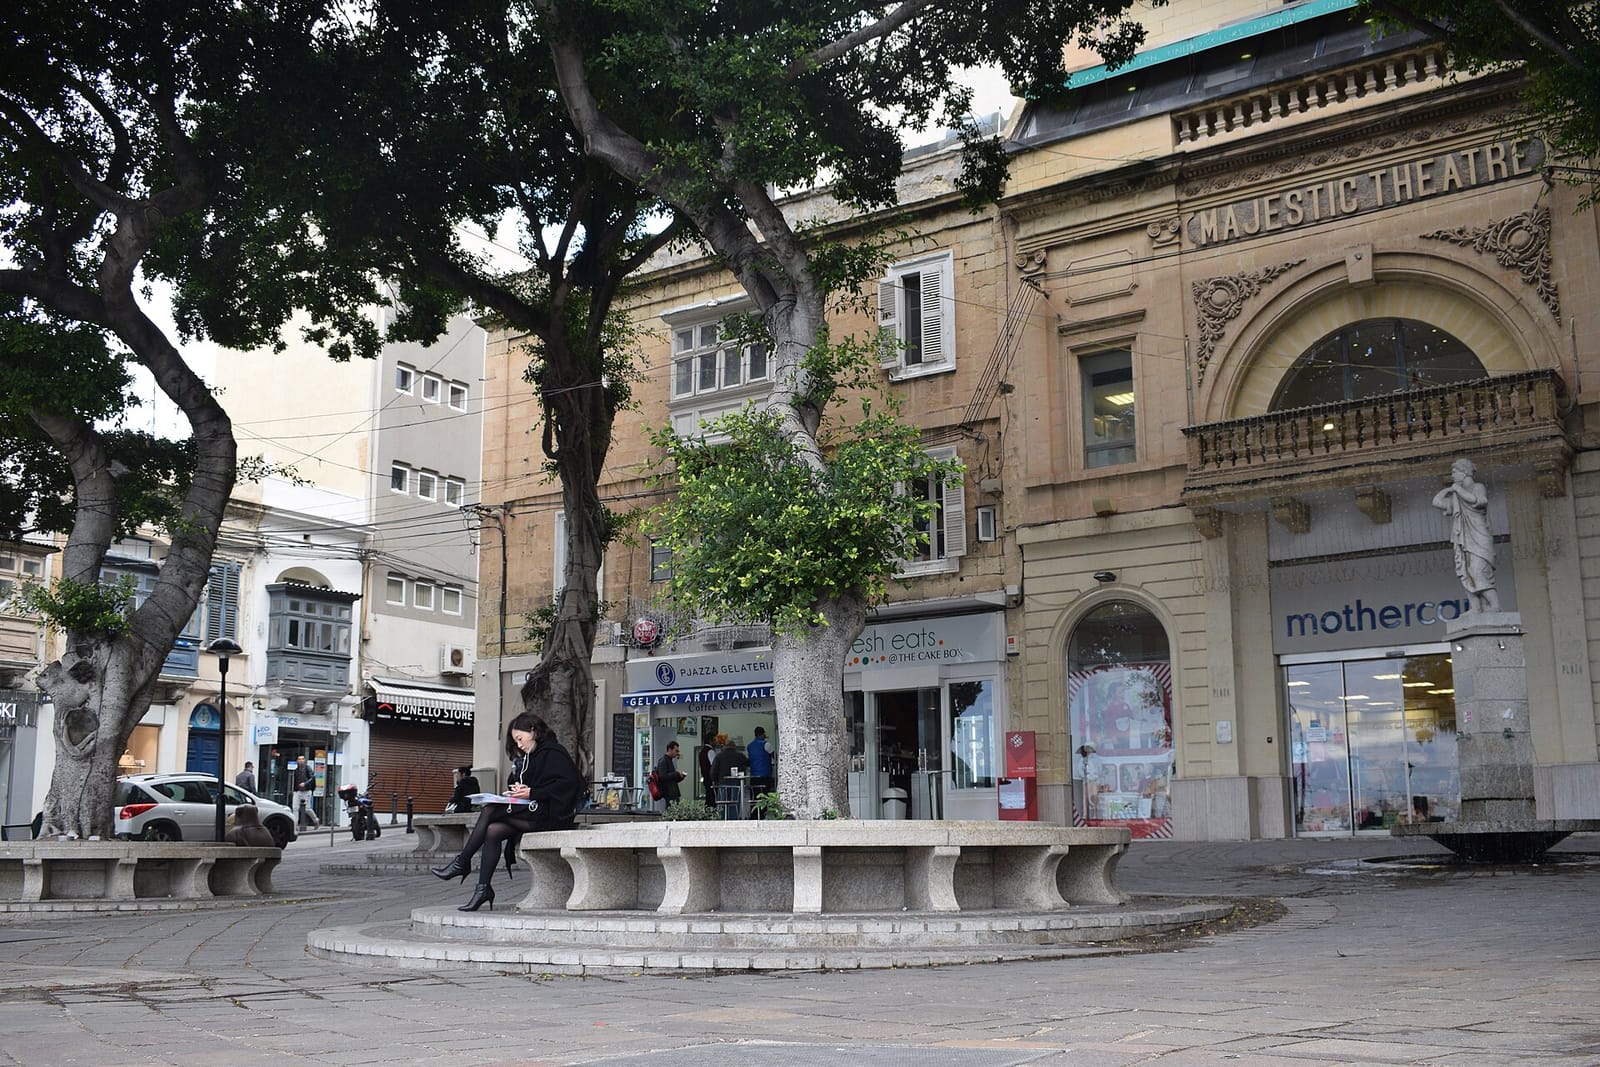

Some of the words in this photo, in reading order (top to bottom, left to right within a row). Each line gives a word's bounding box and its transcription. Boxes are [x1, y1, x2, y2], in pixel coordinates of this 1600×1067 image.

[1200, 178, 1358, 245] MAJESTIC
[1368, 135, 1533, 206] THEATRE
[1286, 599, 1470, 637] motherca
[852, 630, 884, 654] esh
[899, 652, 916, 662] THE
[918, 650, 941, 661] CAKE
[943, 648, 963, 658] BOX
[630, 695, 678, 707] GELATO
[684, 687, 775, 703] ARTIGIANALE
[395, 703, 441, 718] BONELLO
[443, 707, 473, 721] STORE
[688, 702, 717, 713] Coffee
[719, 701, 728, 711] &
[279, 716, 298, 726] PTICS
